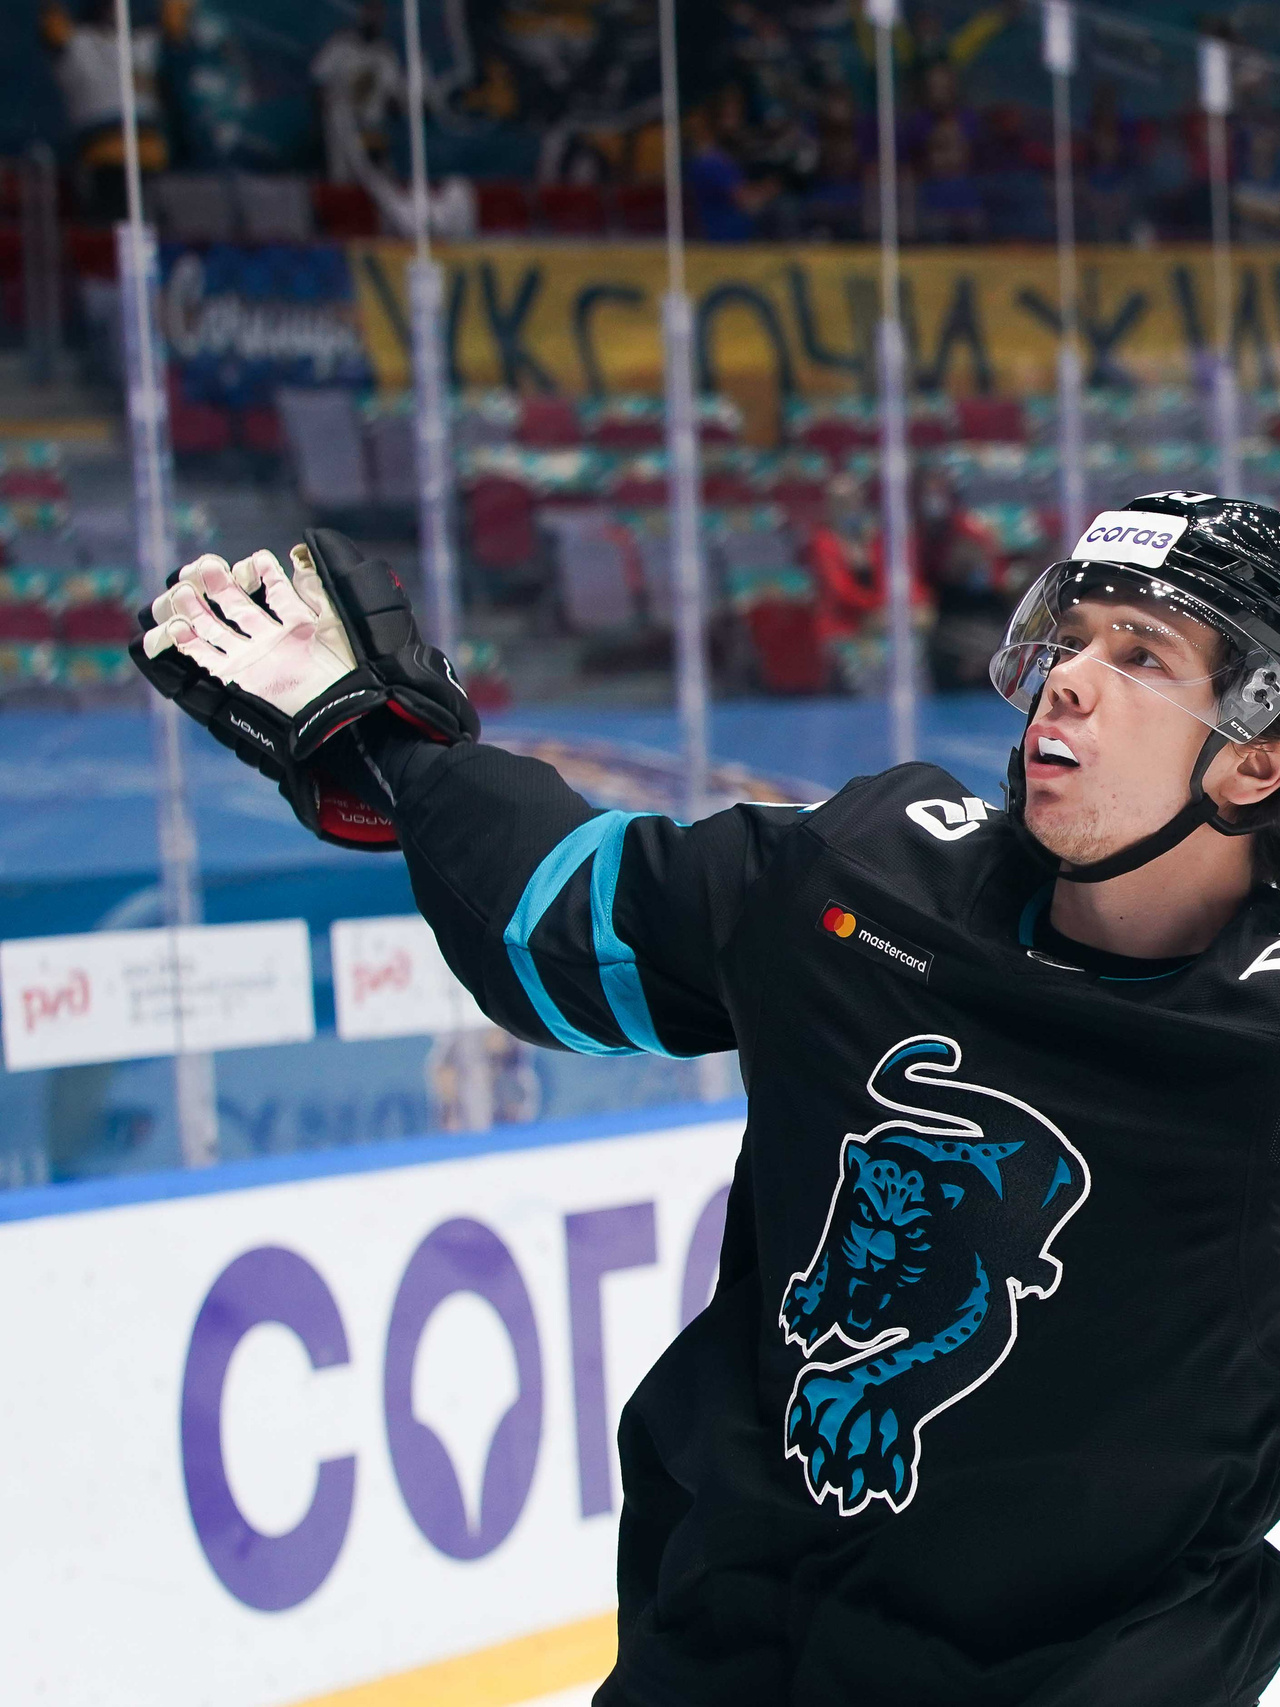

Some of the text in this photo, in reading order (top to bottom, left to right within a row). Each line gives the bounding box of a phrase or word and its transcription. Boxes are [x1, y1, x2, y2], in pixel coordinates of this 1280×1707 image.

[229, 710, 275, 752] VAPOR
[1230, 720, 1252, 740] CCM
[858, 929, 927, 973] mastercard
